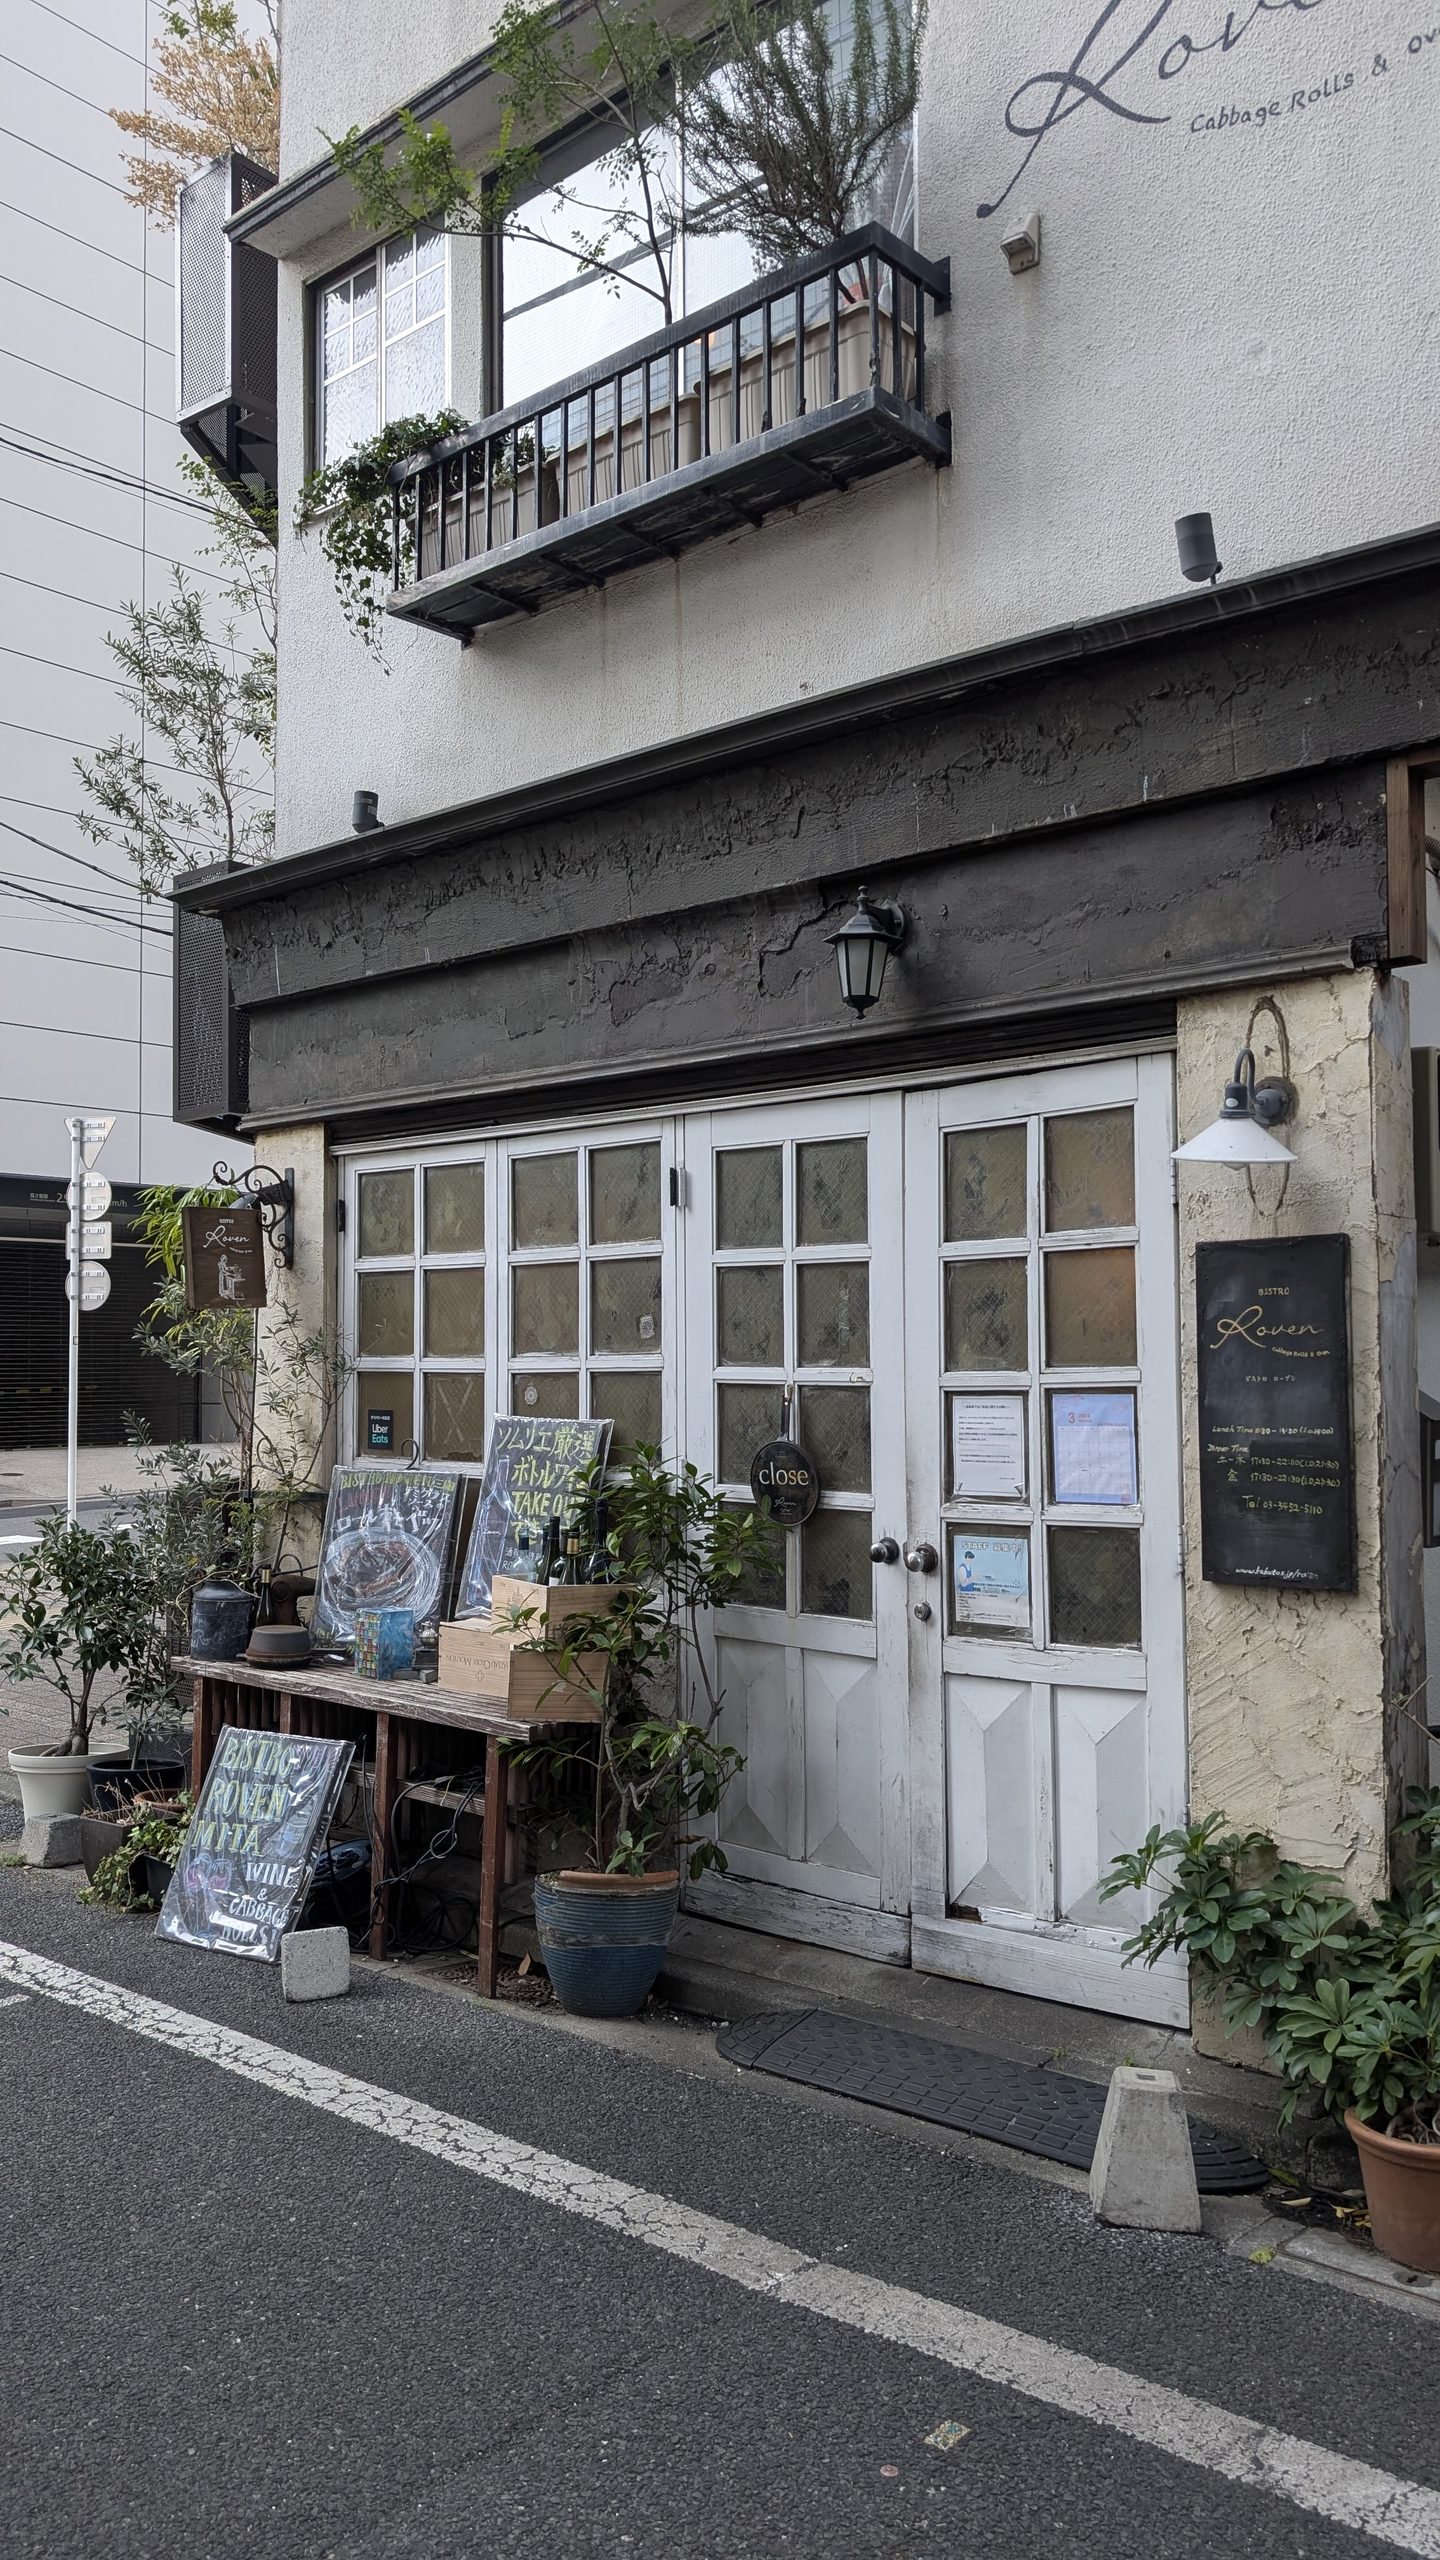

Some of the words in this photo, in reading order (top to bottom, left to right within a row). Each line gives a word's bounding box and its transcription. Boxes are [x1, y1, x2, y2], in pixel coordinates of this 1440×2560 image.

[1190, 103, 1281, 134] Cabbage
[1289, 72, 1355, 113] Rolls
[1371, 54, 1389, 77] &
[1258, 1287, 1290, 1296] BISTRO
[1209, 1305, 1324, 1349] Roven
[371, 1423, 389, 1434] Uber
[371, 1434, 389, 1444] Eats
[1212, 1424, 1235, 1433] Lunch
[1207, 1443, 1230, 1453] Dinner
[1230, 1443, 1249, 1453] Time
[758, 1461, 810, 1486] close
[511, 1490, 552, 1517] TAKE
[1241, 1494, 1260, 1509] Tel
[1262, 1500, 1323, 1515] 03-3452-5110
[962, 1541, 988, 1551] STAFF
[219, 1736, 297, 1778] BISTRO
[204, 1777, 291, 1823] ROVEN
[191, 1819, 263, 1857] MITA
[256, 1887, 268, 1901] &
